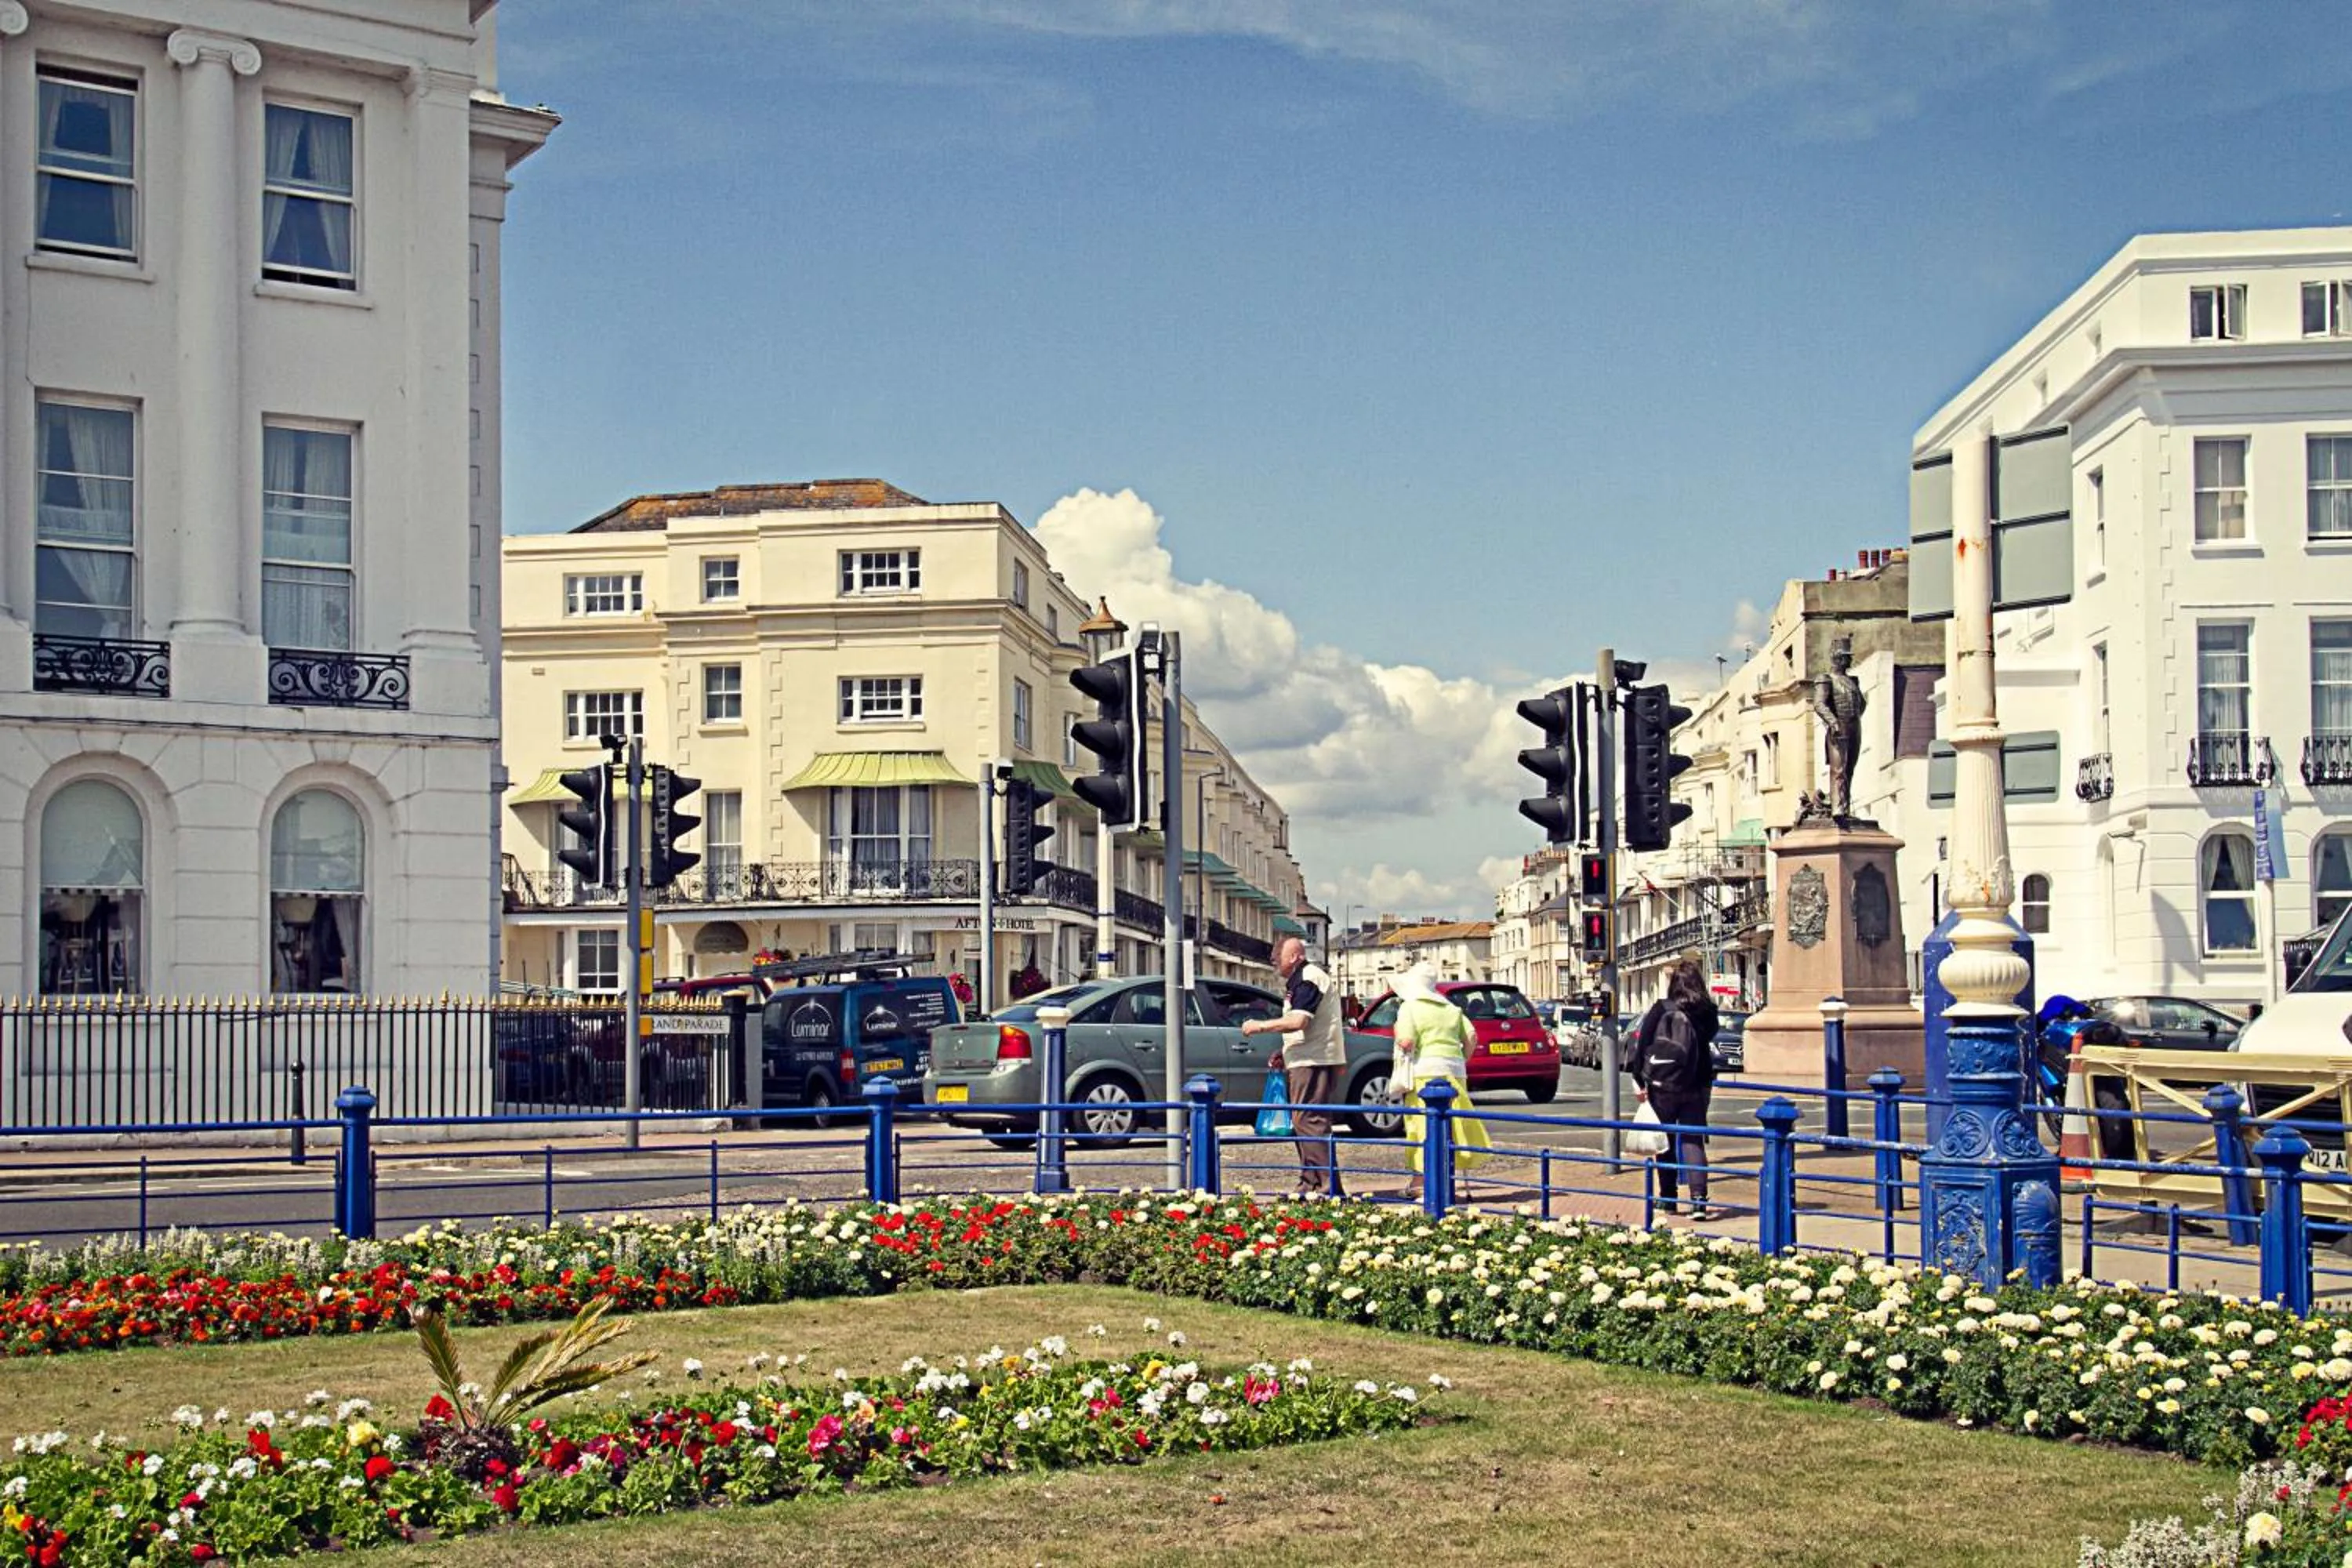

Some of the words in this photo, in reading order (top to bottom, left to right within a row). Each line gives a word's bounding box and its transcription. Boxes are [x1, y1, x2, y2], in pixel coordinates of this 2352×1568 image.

[955, 917, 996, 928] AFTN
[1006, 918, 1036, 929] HOTEL
[684, 1019, 725, 1029] PARADE
[790, 1018, 831, 1037] Luminar
